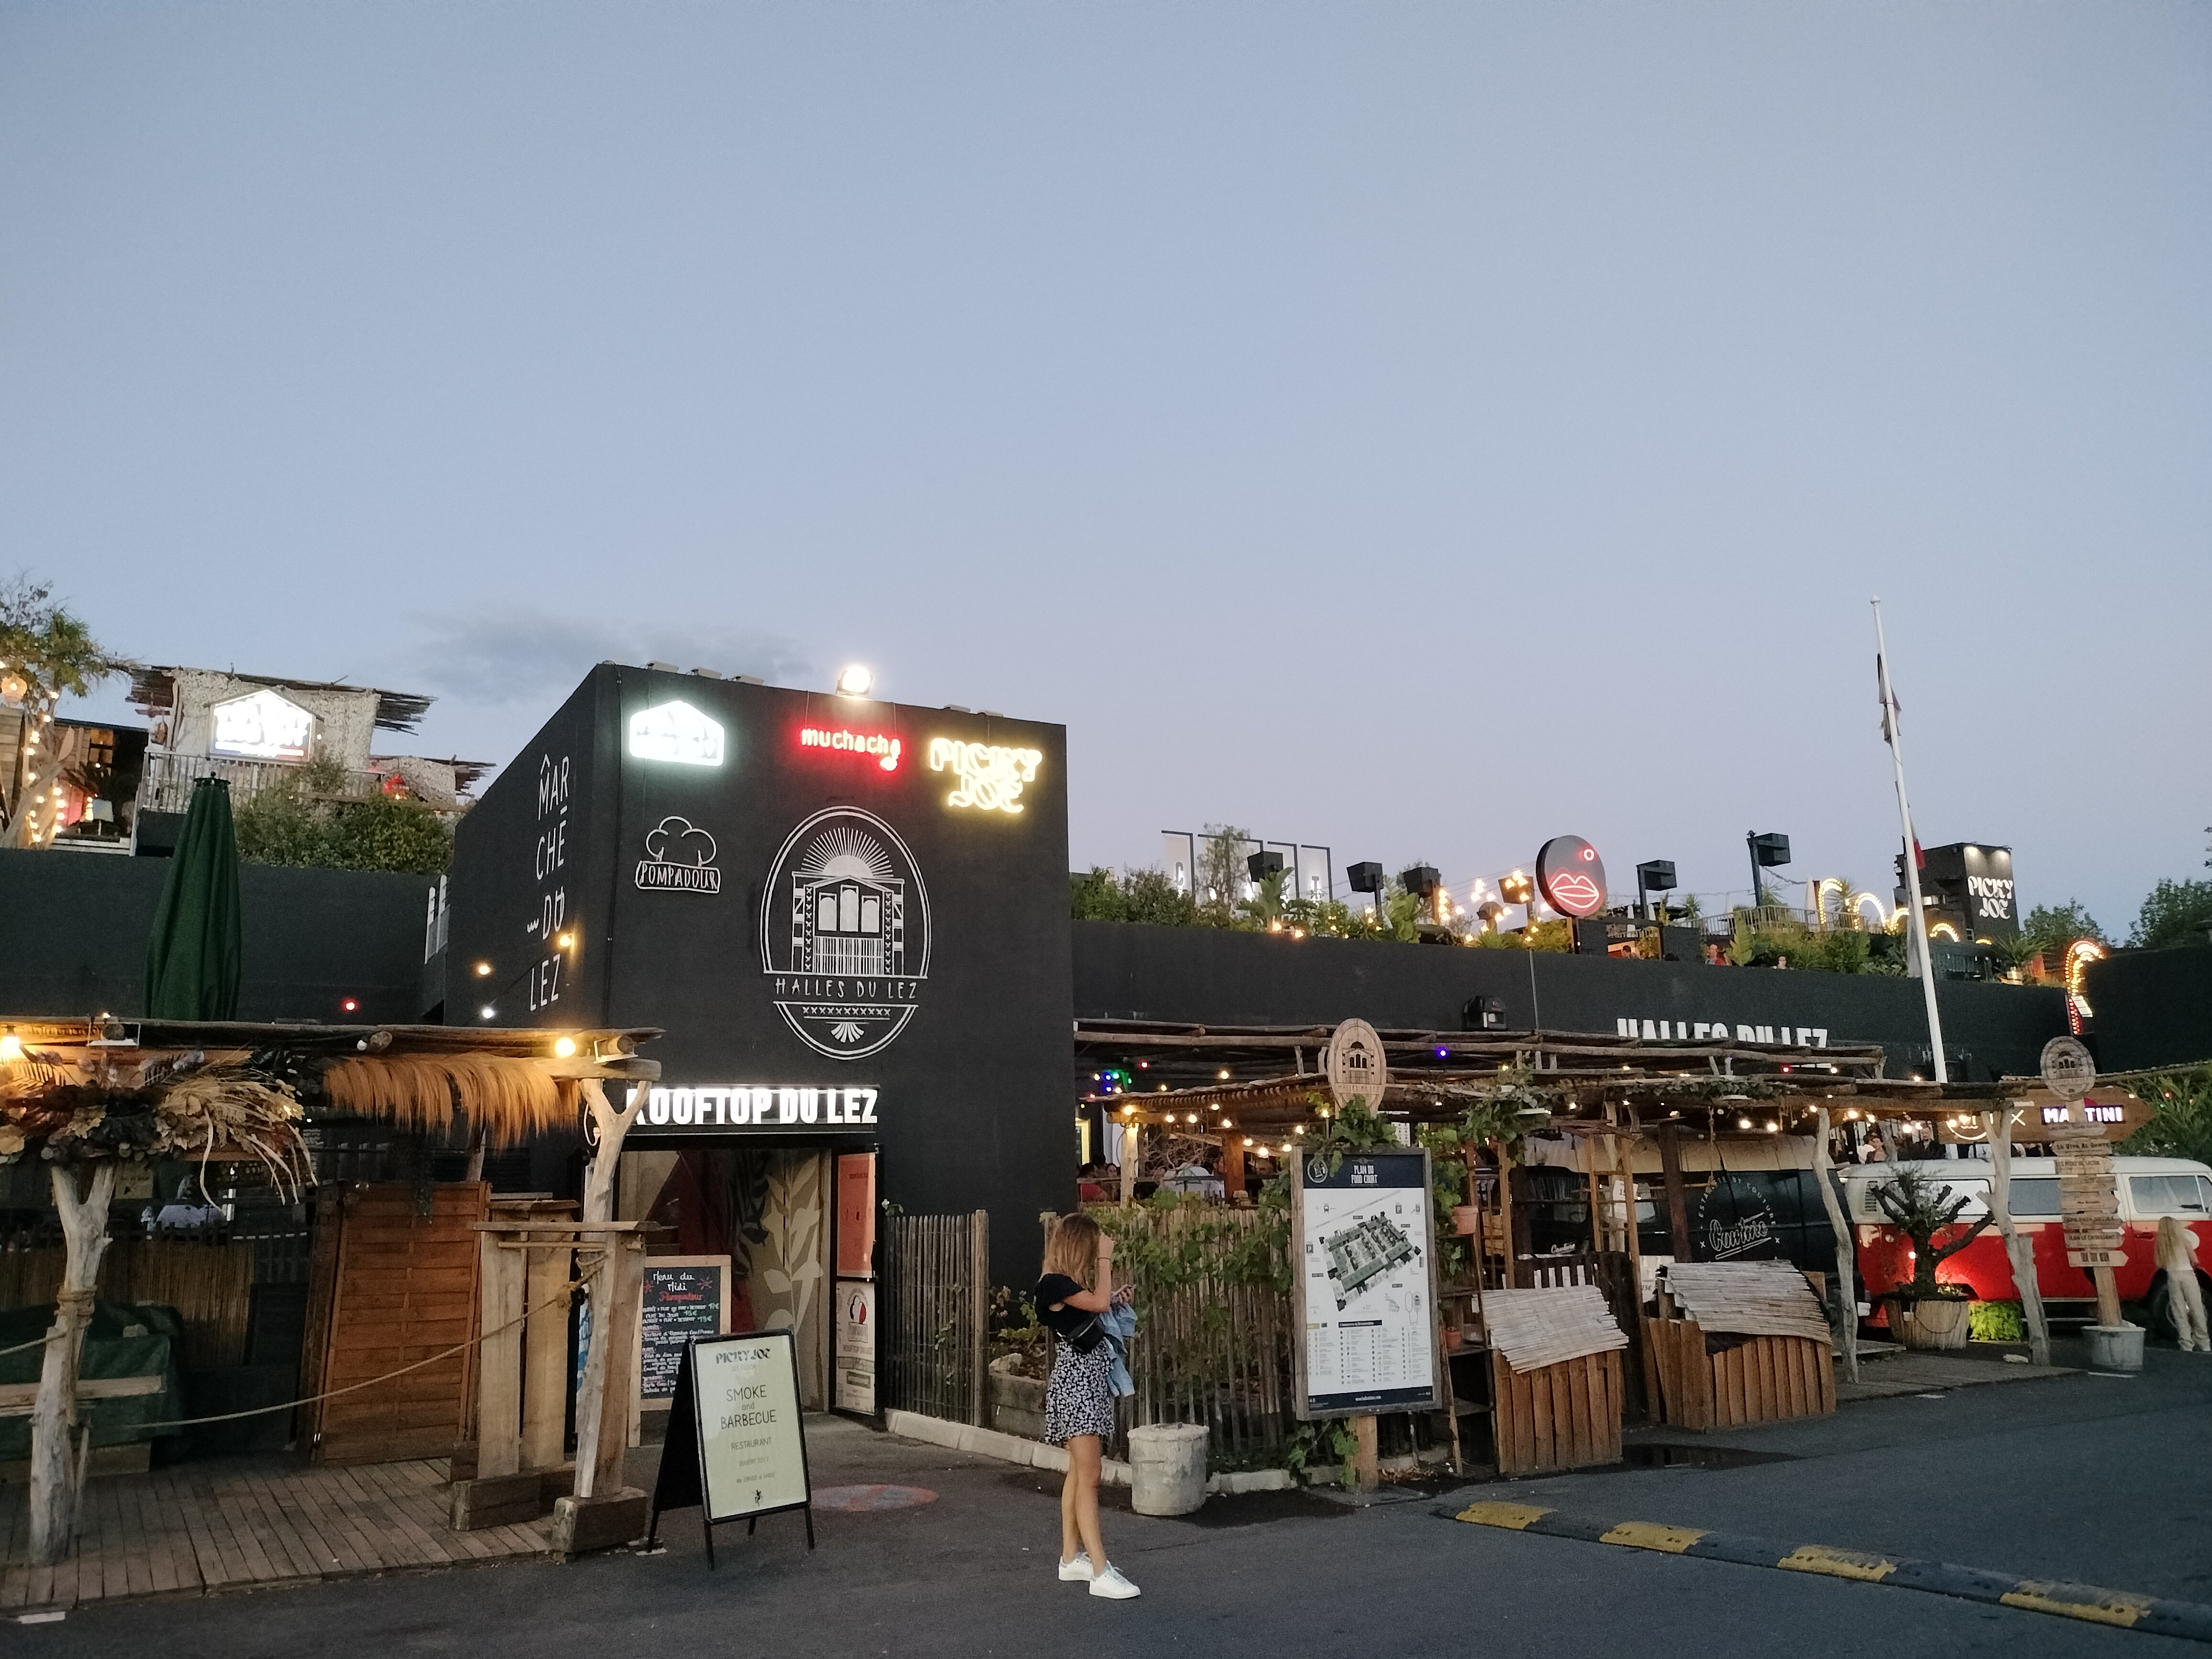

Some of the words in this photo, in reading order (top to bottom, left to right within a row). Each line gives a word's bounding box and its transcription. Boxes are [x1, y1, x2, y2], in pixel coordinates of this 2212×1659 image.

[639, 863, 718, 889] POMPADOUR
[1968, 875, 2013, 899] PICKY
[1979, 897, 2011, 919] JOE
[530, 953, 561, 1012] LEZ
[775, 978, 845, 998] HALLES
[856, 981, 877, 998] DU
[888, 982, 917, 999] LEZ
[780, 1088, 818, 1124] DU
[827, 1088, 878, 1124] LEZ
[2044, 1106, 2123, 1123] MATINI
[1354, 1165, 1367, 1174] PLAN
[1368, 1165, 1374, 1174] DU
[1351, 1174, 1363, 1184] FOOD
[1363, 1174, 1378, 1184] COURT
[1709, 1212, 1769, 1252] Couture
[653, 1271, 674, 1284] Menu
[680, 1272, 695, 1280] du
[716, 1350, 750, 1364] PICKY
[750, 1348, 771, 1360] JOE
[726, 1385, 767, 1402] SMOKE
[741, 1402, 755, 1411] and
[720, 1409, 777, 1430] BARBECUE
[730, 1437, 772, 1451] RESTAURANT
[738, 1458, 755, 1467] OUVERT
